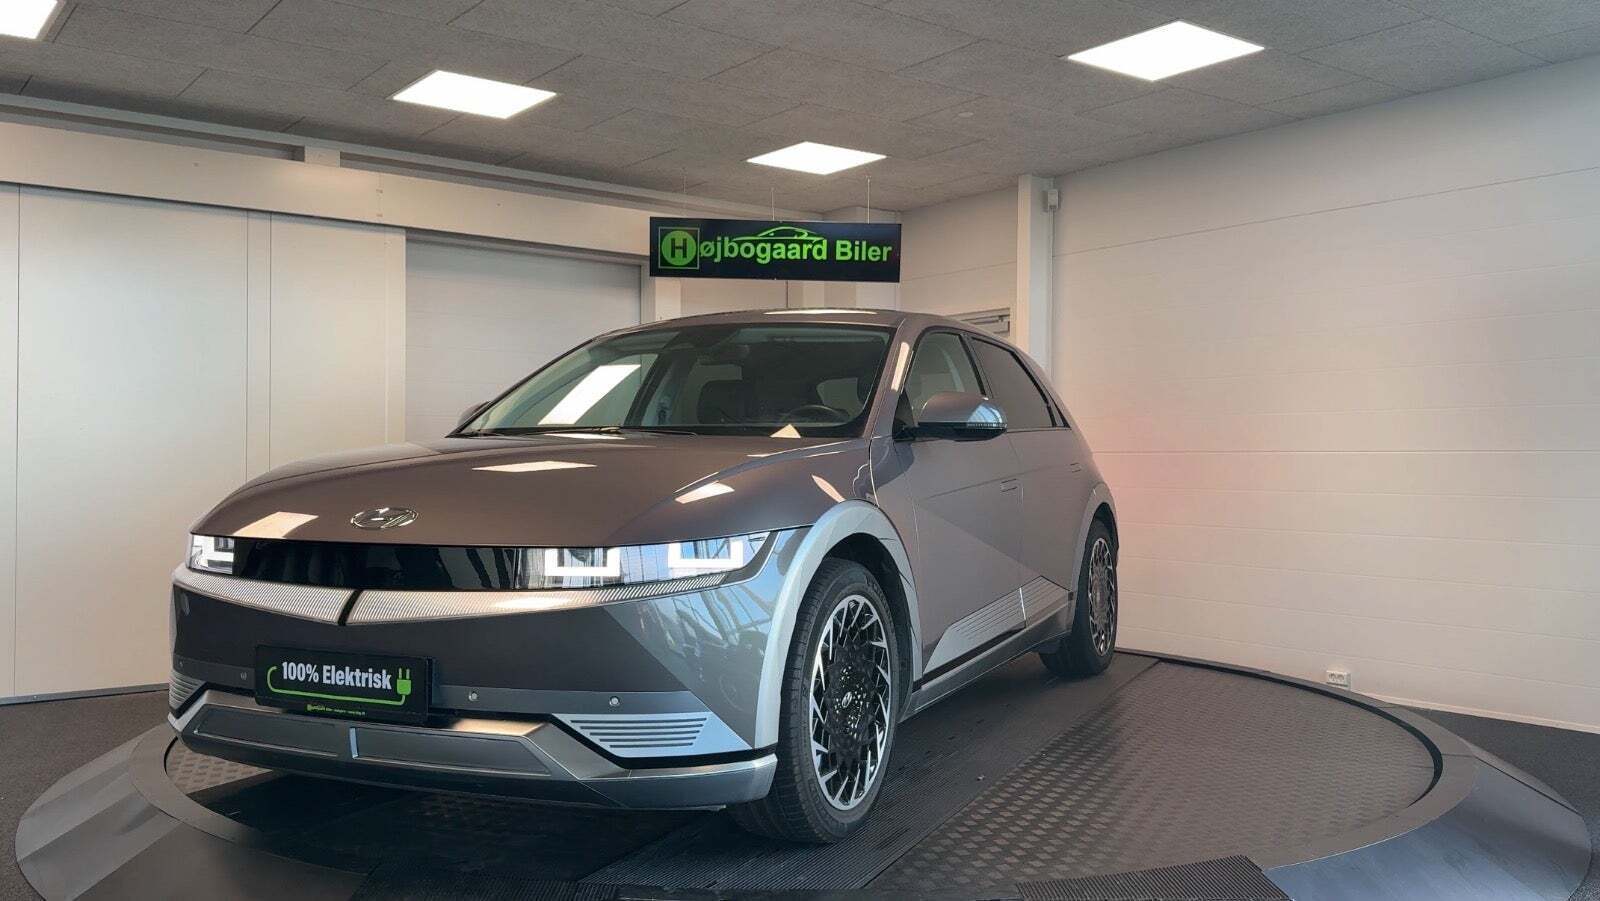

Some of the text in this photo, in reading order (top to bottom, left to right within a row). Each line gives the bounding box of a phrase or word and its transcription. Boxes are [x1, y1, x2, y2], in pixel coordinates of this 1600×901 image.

[836, 239, 893, 262] Biler
[282, 661, 392, 690] 100% Elektrisk
